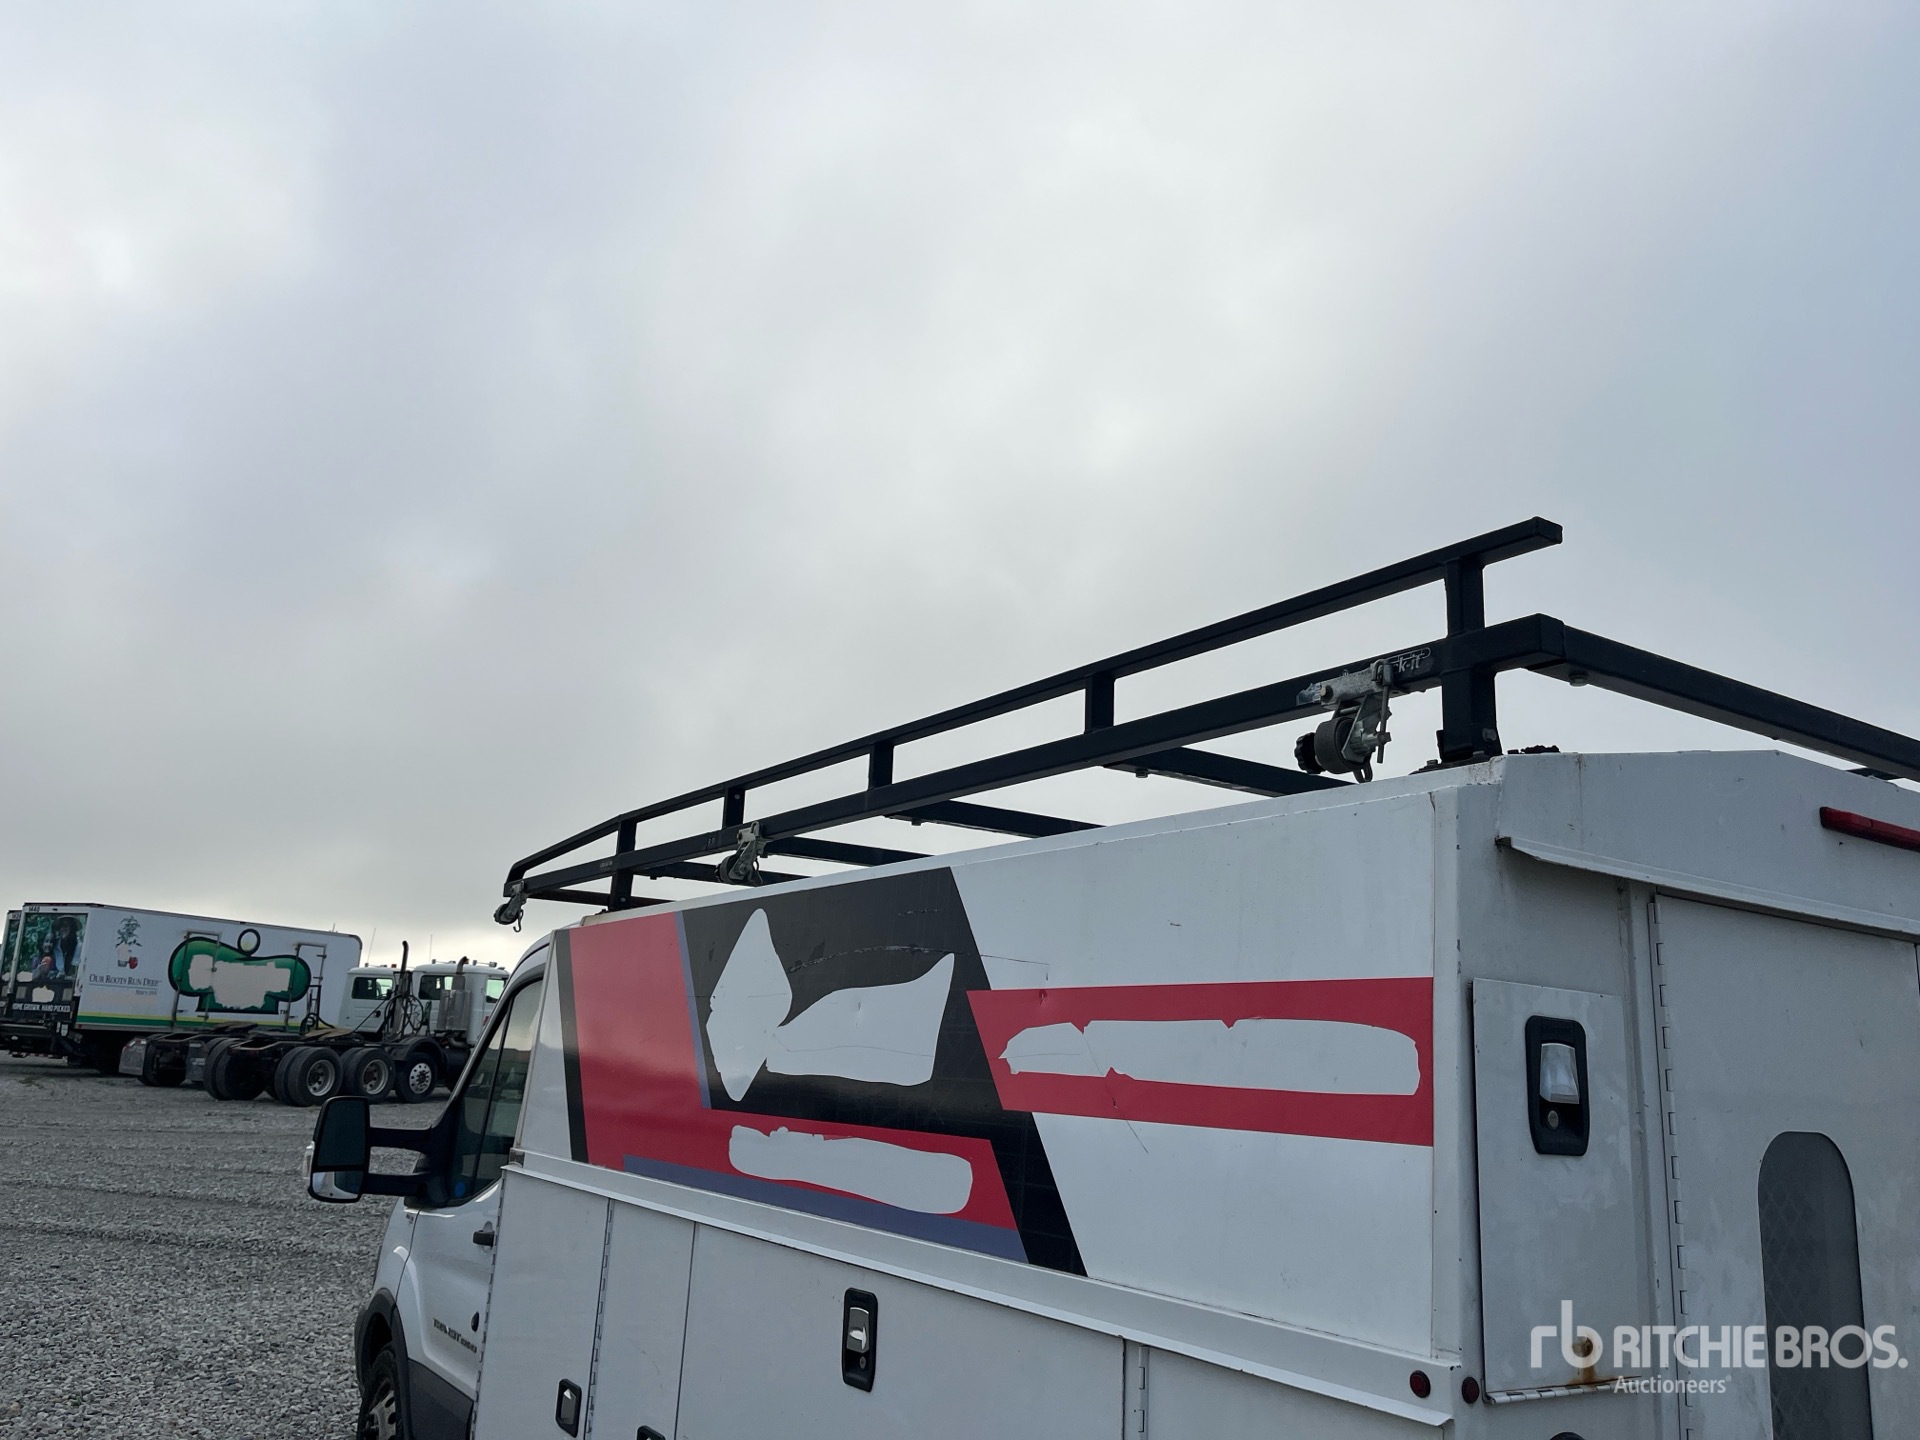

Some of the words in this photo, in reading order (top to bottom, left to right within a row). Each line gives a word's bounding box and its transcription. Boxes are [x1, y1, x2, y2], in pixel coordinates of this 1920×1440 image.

[89, 974, 104, 983] OUR
[105, 975, 126, 985] ROOTS
[127, 977, 142, 986] RUN
